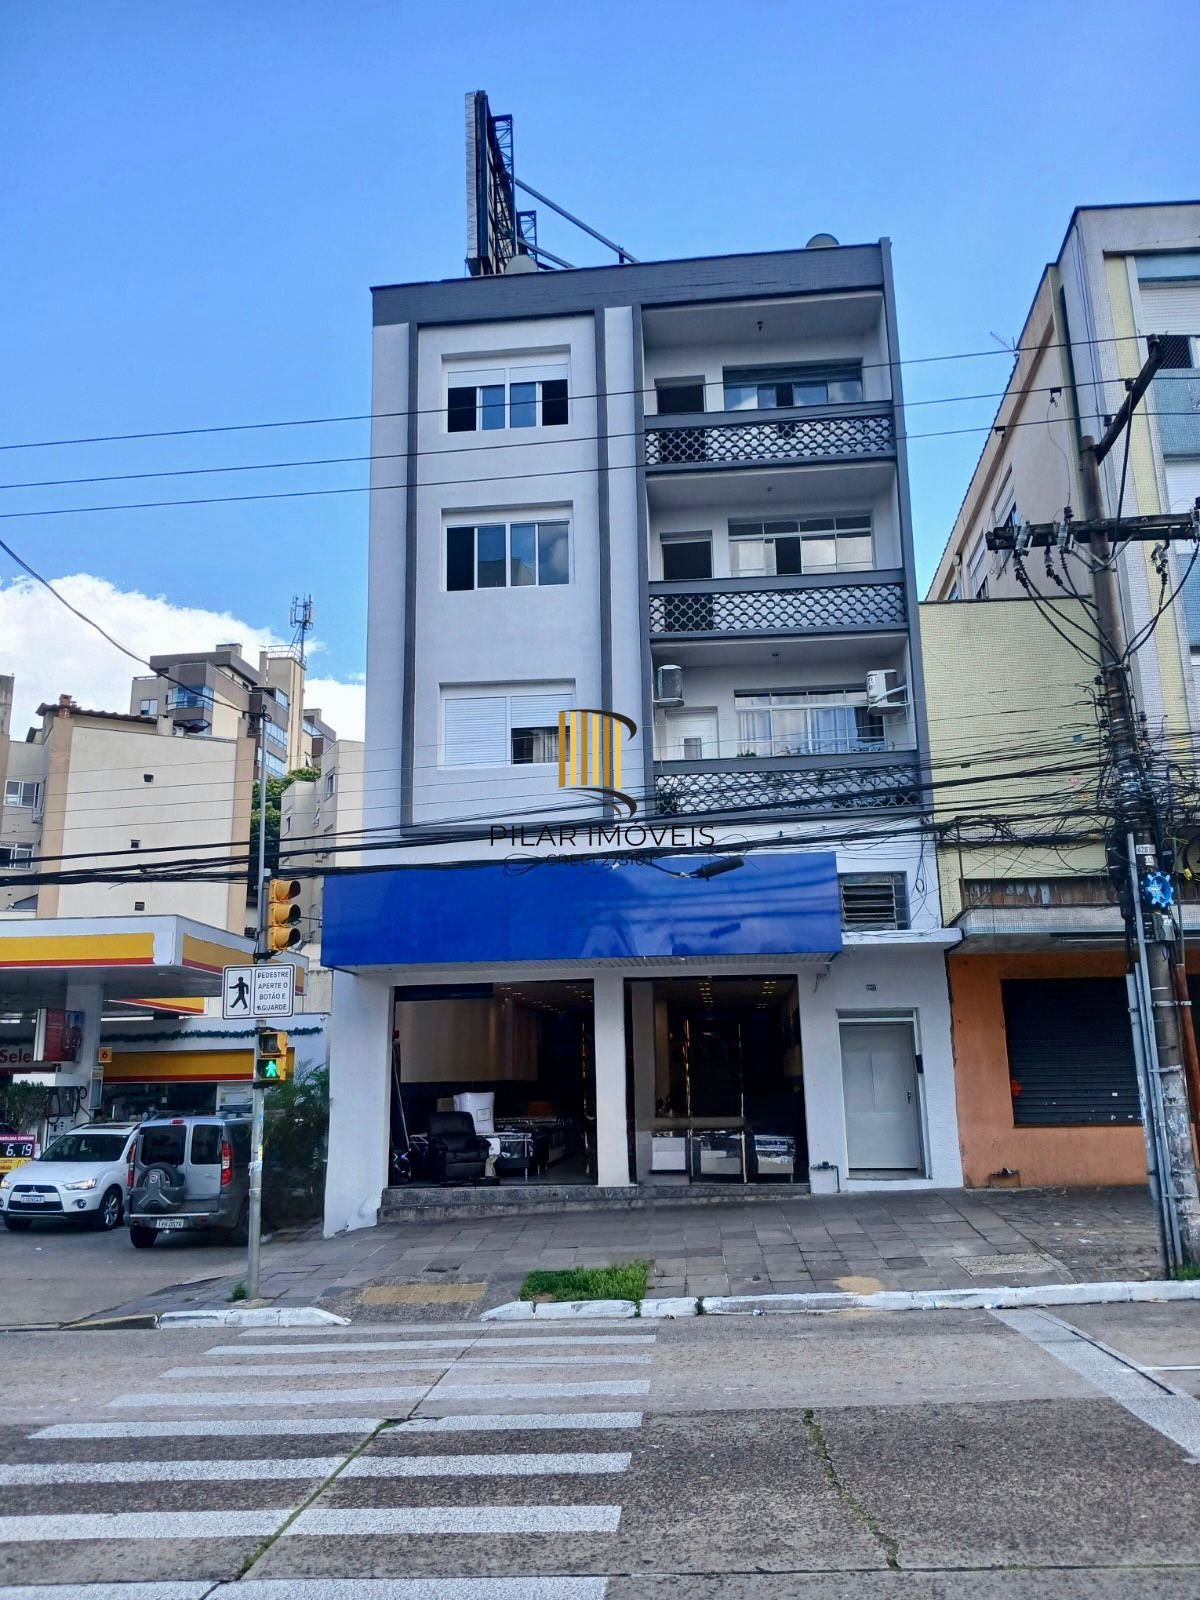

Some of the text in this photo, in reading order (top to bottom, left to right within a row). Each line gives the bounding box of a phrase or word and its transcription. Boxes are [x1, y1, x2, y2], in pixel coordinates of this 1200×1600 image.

[257, 971, 289, 979] PEDESTRE
[257, 982, 281, 990] APERTE
[259, 992, 280, 1000] BOTÃO
[6, 1143, 32, 1157] 6.19
